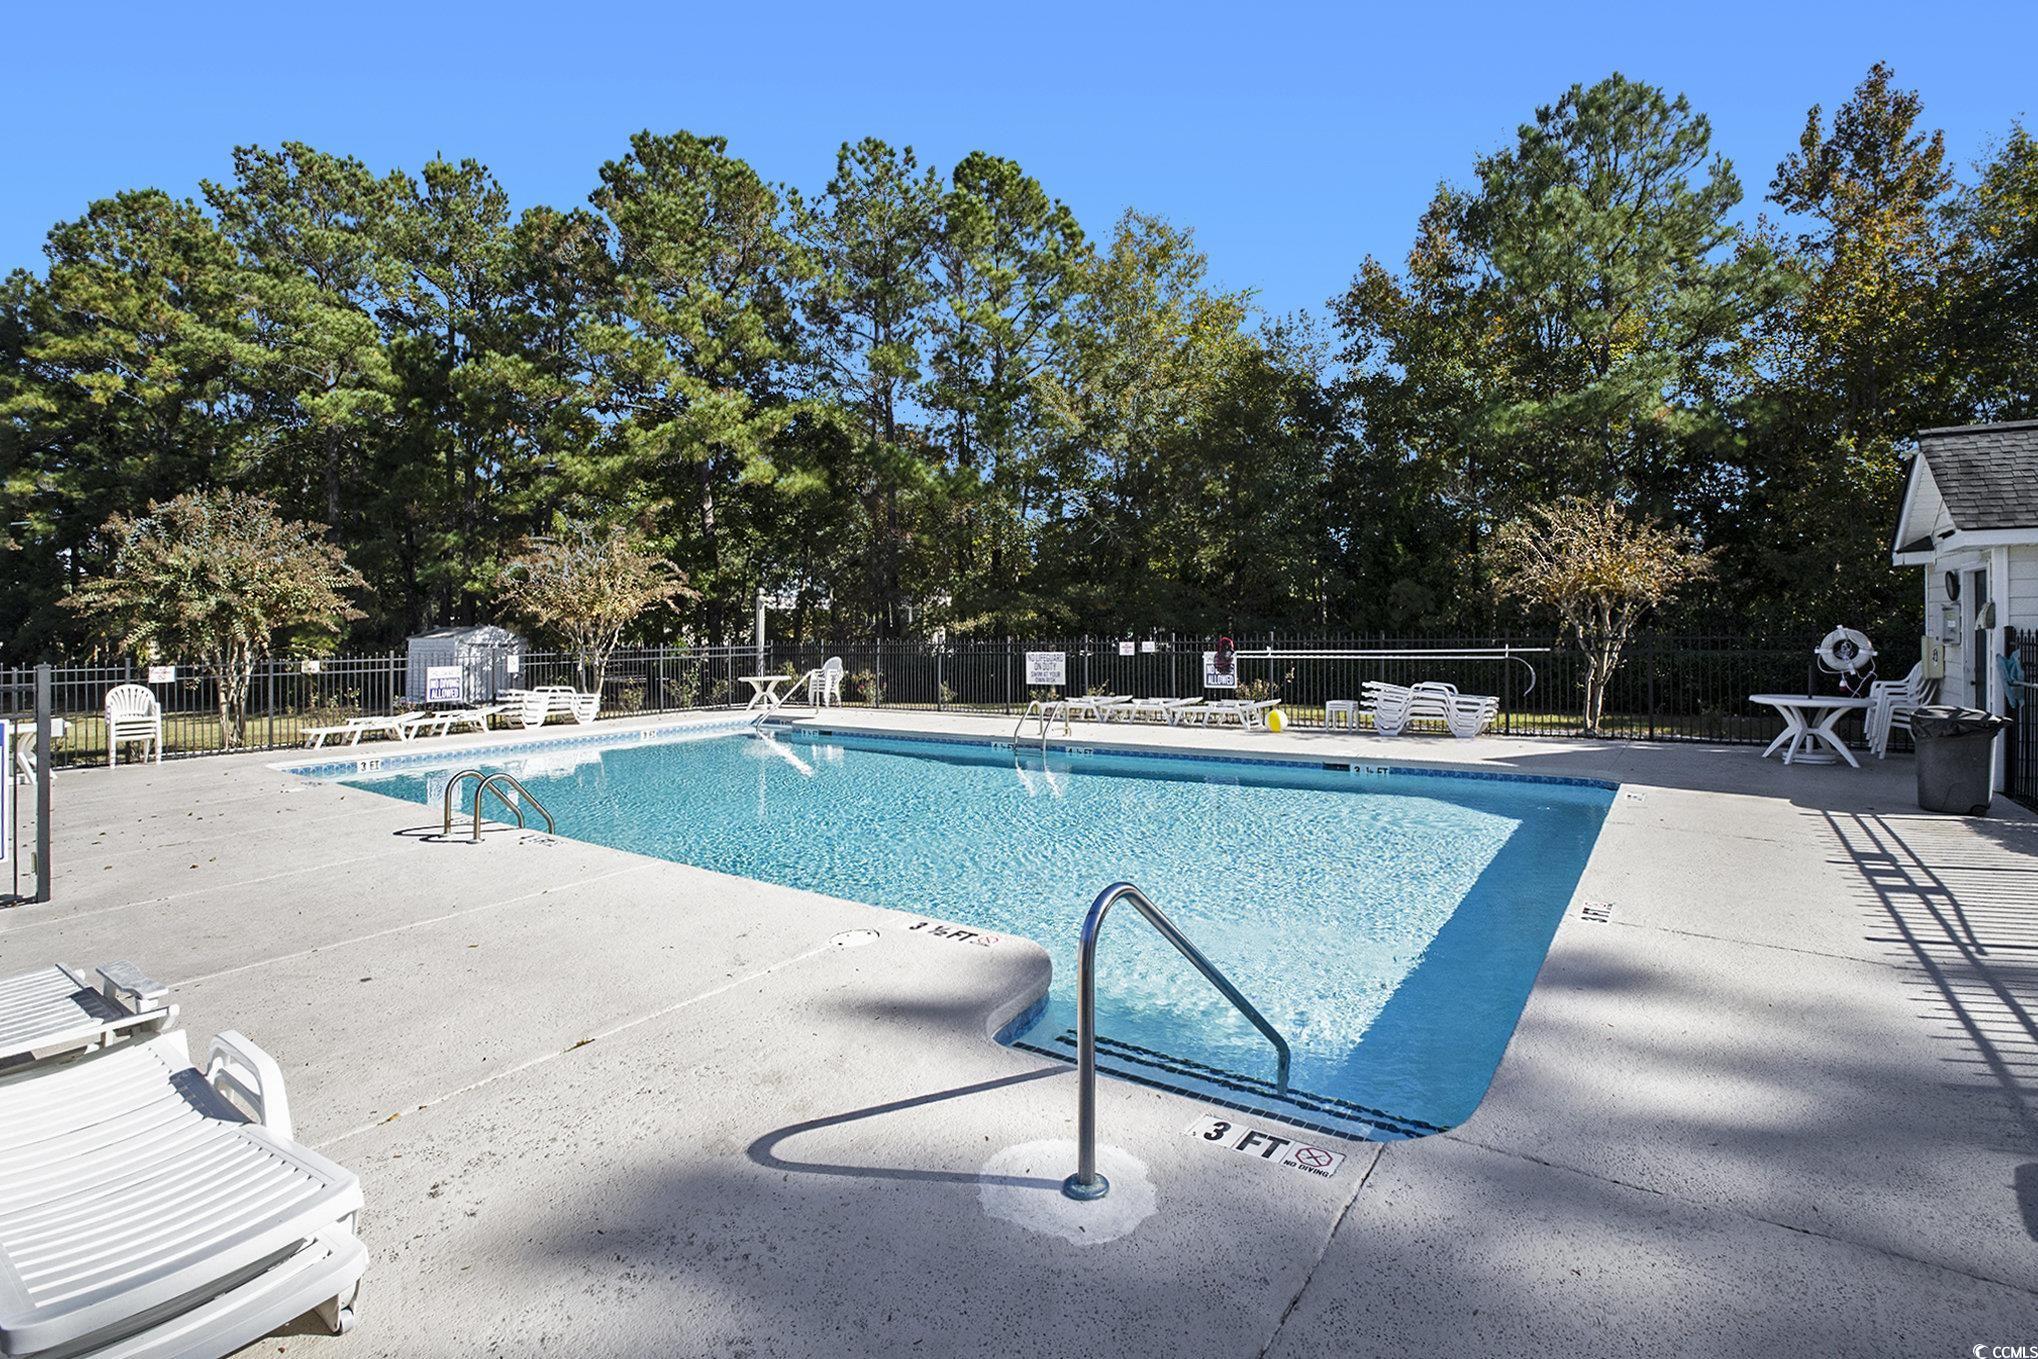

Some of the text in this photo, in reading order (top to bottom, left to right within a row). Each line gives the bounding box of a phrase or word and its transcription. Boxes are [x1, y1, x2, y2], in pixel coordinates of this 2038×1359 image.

[1208, 674, 1234, 685] ALLOWED
[431, 688, 459, 699] ALLOWED
[1203, 1121, 1291, 1159] 3 FT
[1283, 1159, 1330, 1178] NO DIVING
